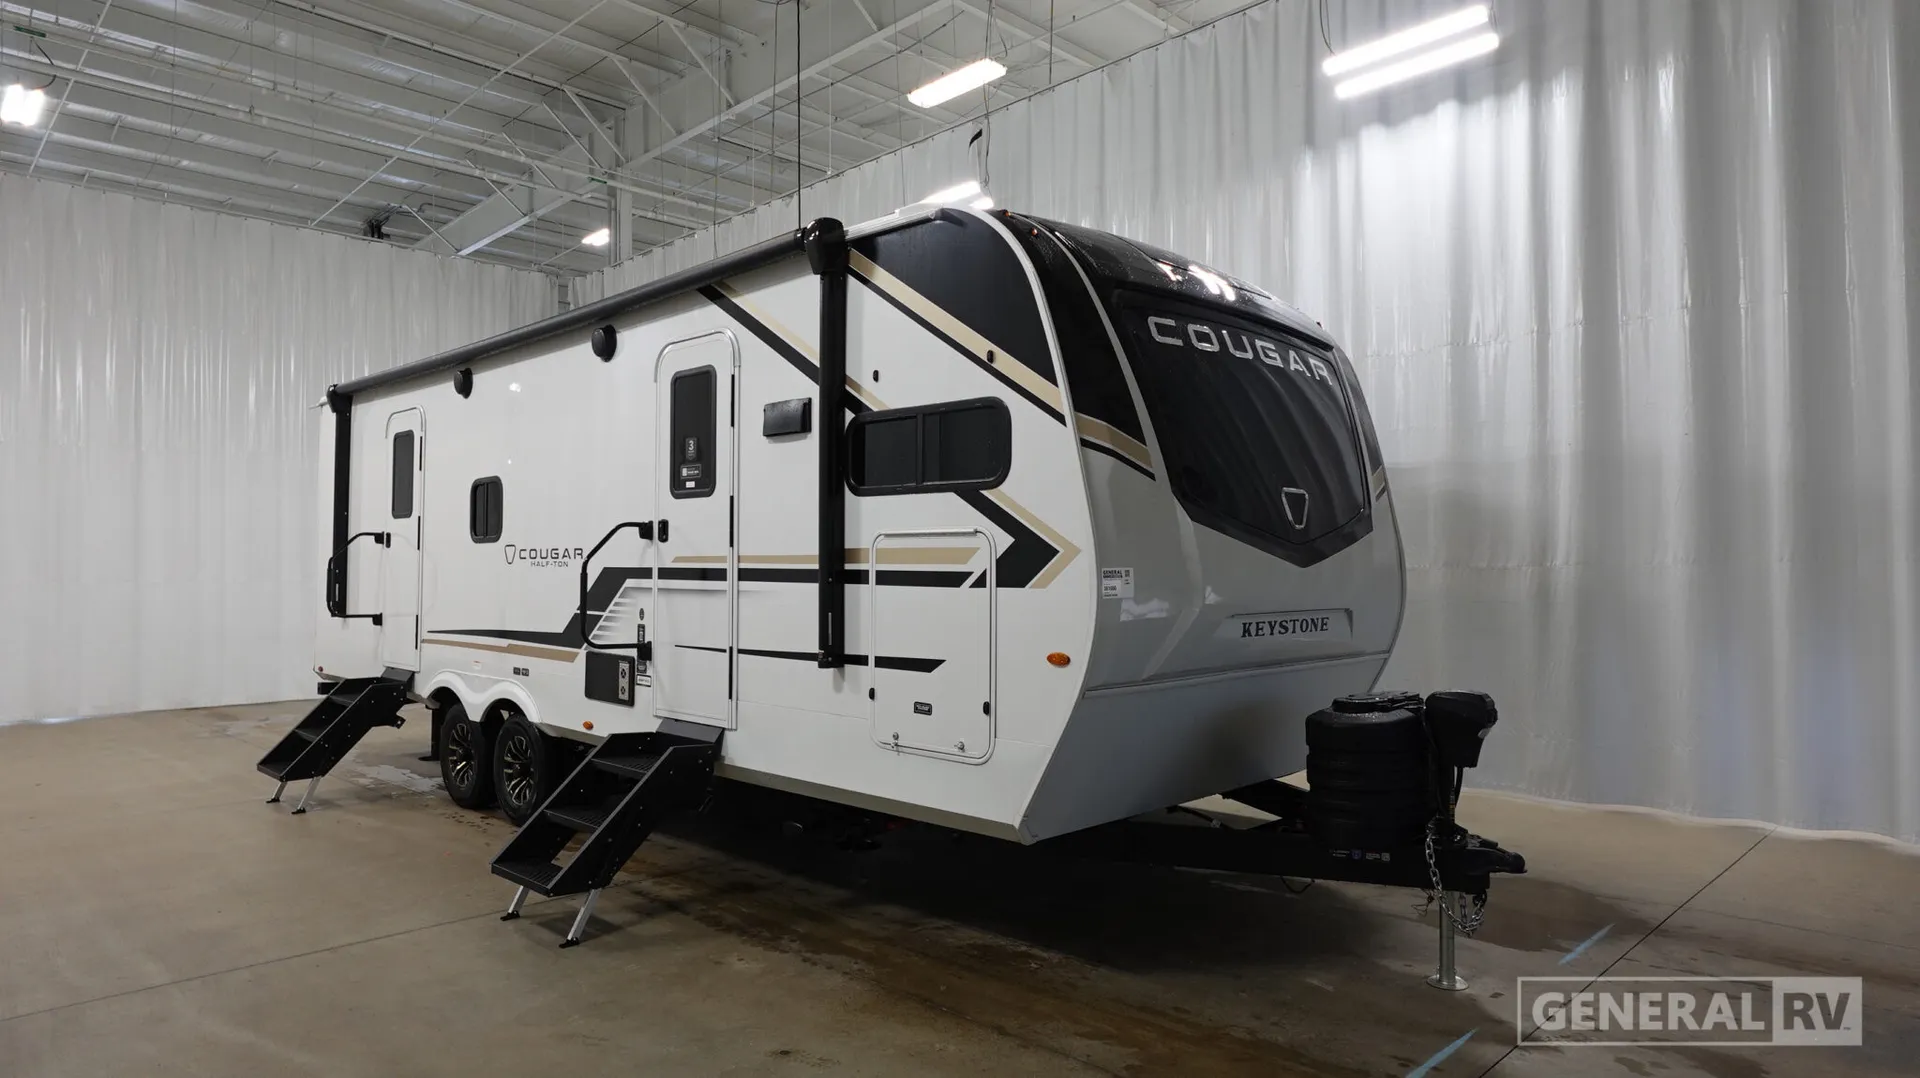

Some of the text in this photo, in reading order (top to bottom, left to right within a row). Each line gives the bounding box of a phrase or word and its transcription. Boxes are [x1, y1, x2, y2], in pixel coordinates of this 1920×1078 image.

[1148, 316, 1332, 385] COUGAR
[519, 548, 583, 560] COUGAR
[1241, 617, 1329, 638] KEYSTONE
